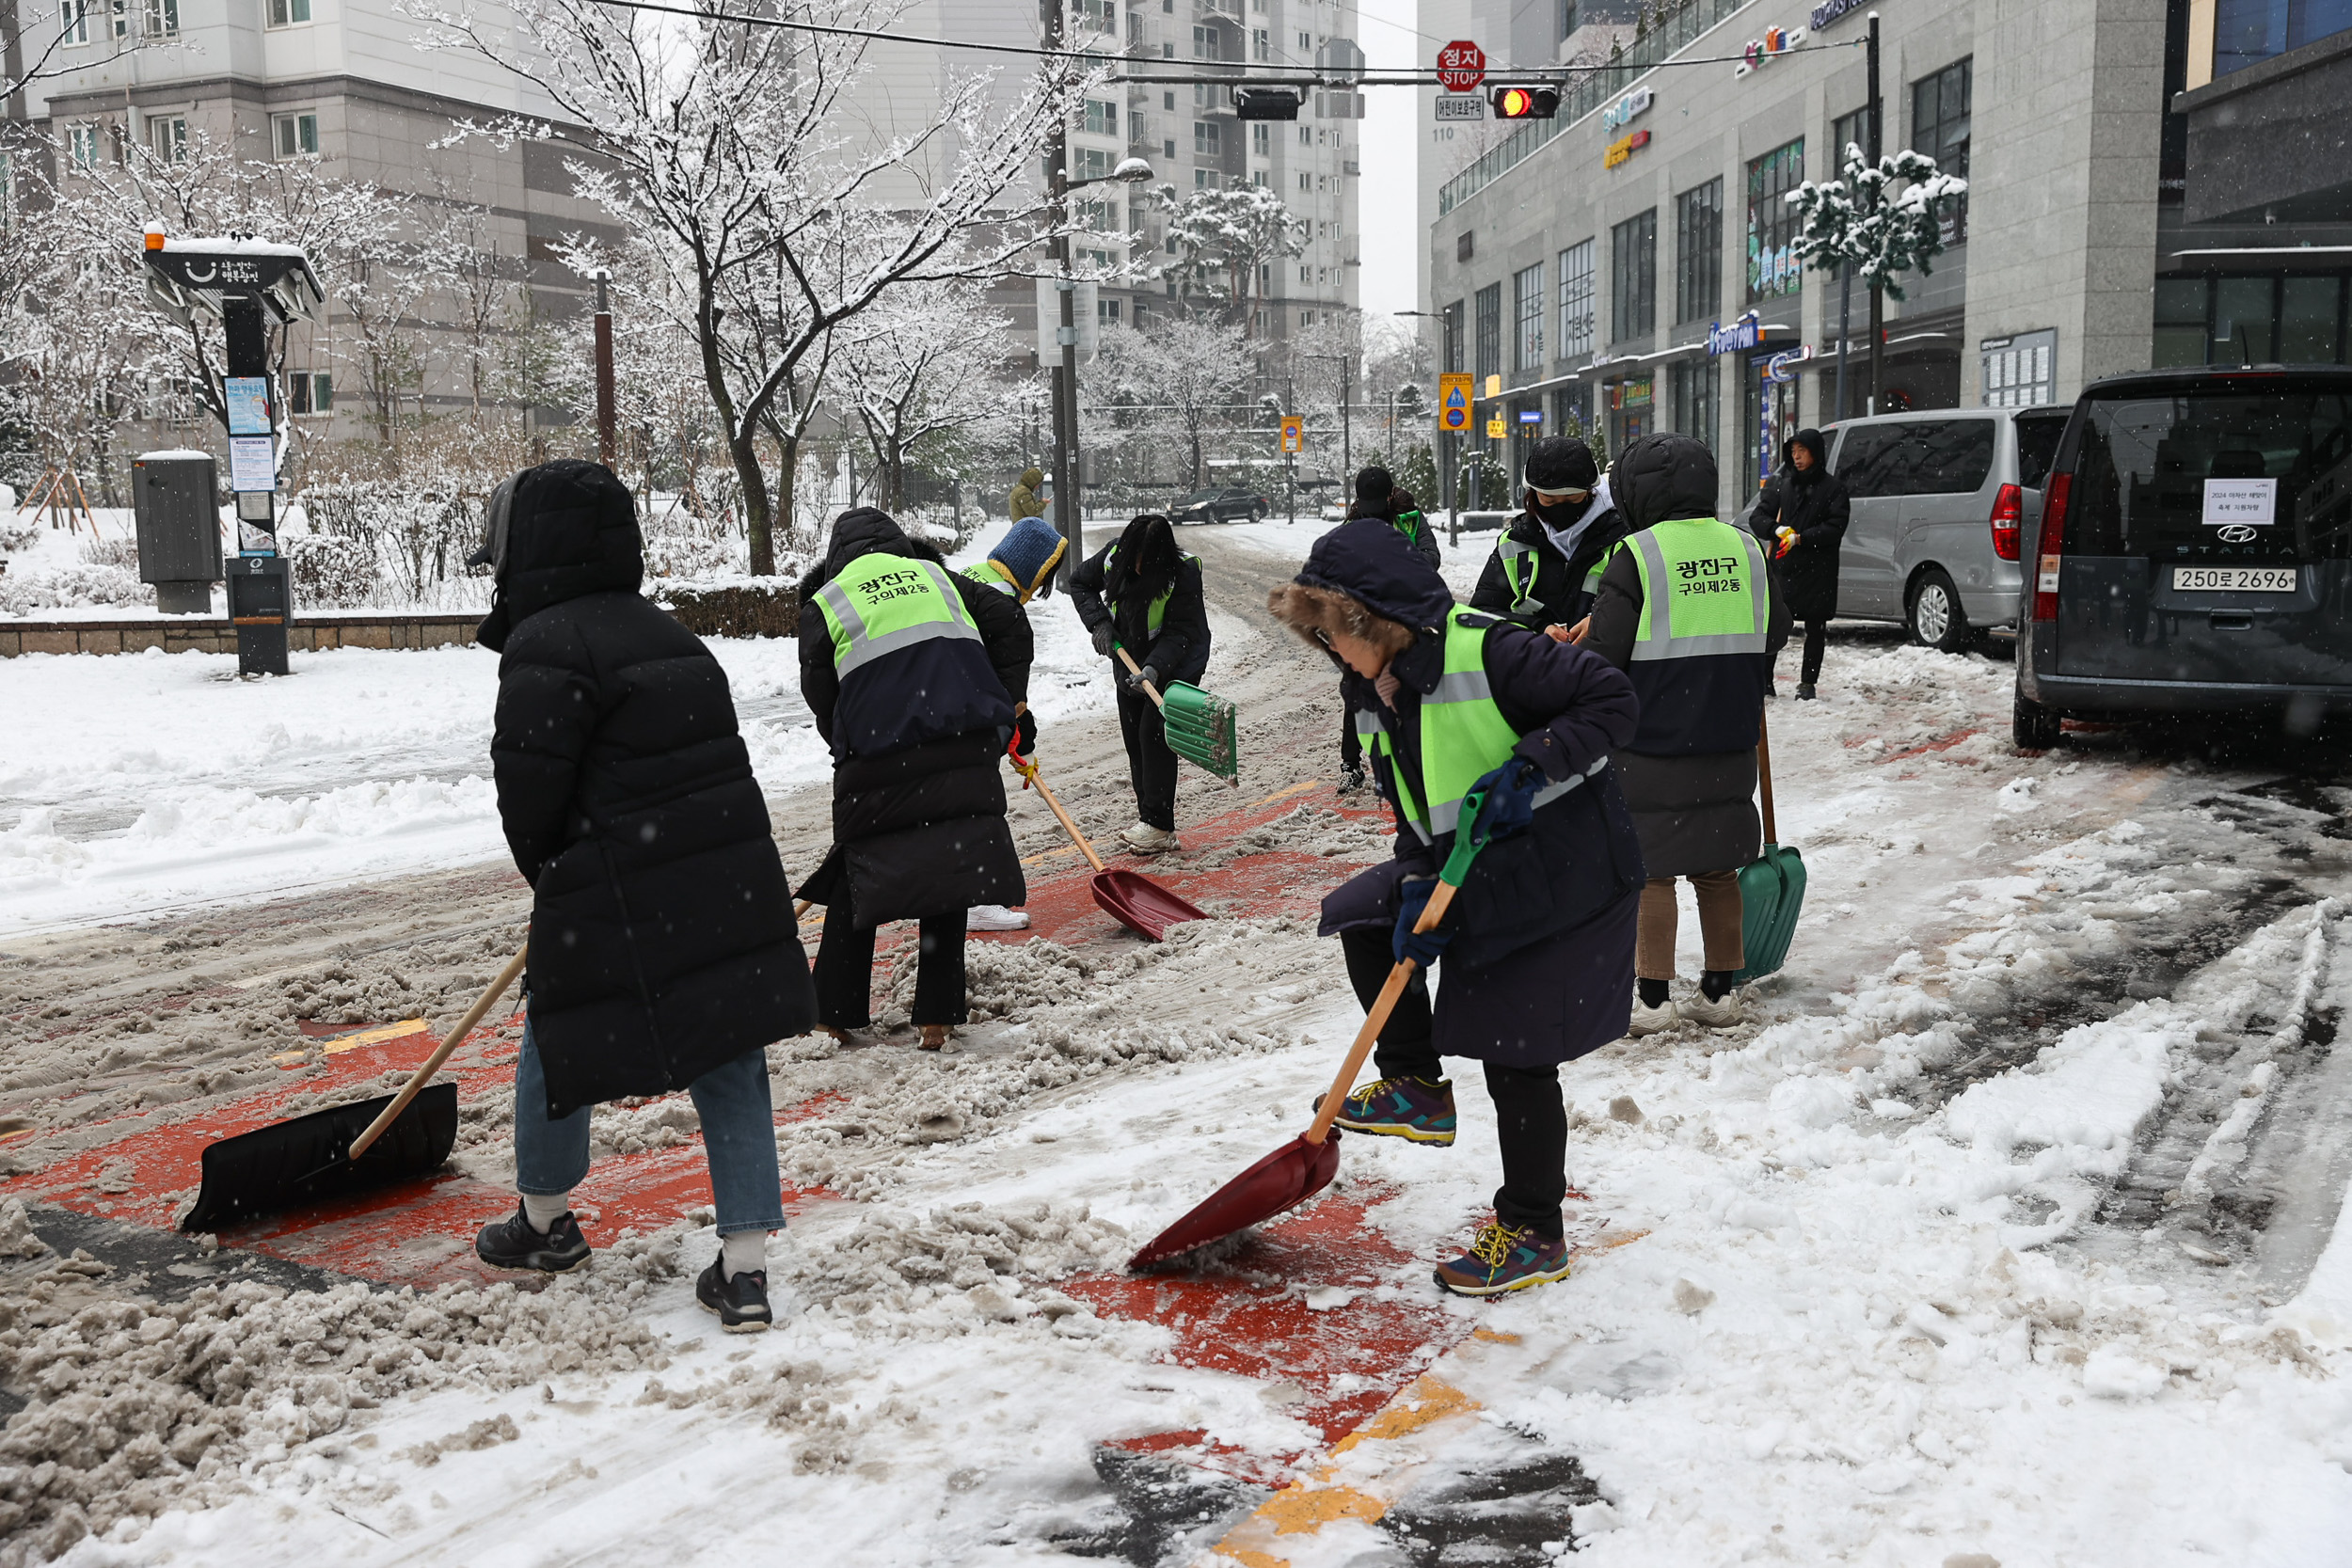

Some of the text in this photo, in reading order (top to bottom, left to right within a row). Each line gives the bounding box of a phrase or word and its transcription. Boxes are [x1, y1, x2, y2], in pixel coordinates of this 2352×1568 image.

[1443, 48, 1478, 68] 정지
[1443, 71, 1478, 86] STOP
[1438, 100, 1481, 117] 어린이보호구역
[1433, 127, 1454, 143] 110
[222, 269, 259, 283] 행복광진
[1676, 557, 1739, 578] 광진구
[858, 570, 920, 594] 광진구
[1678, 578, 1740, 595] 구의제2동
[2182, 571, 2288, 588] 250로 2696
[866, 583, 930, 605] 구의제2동
